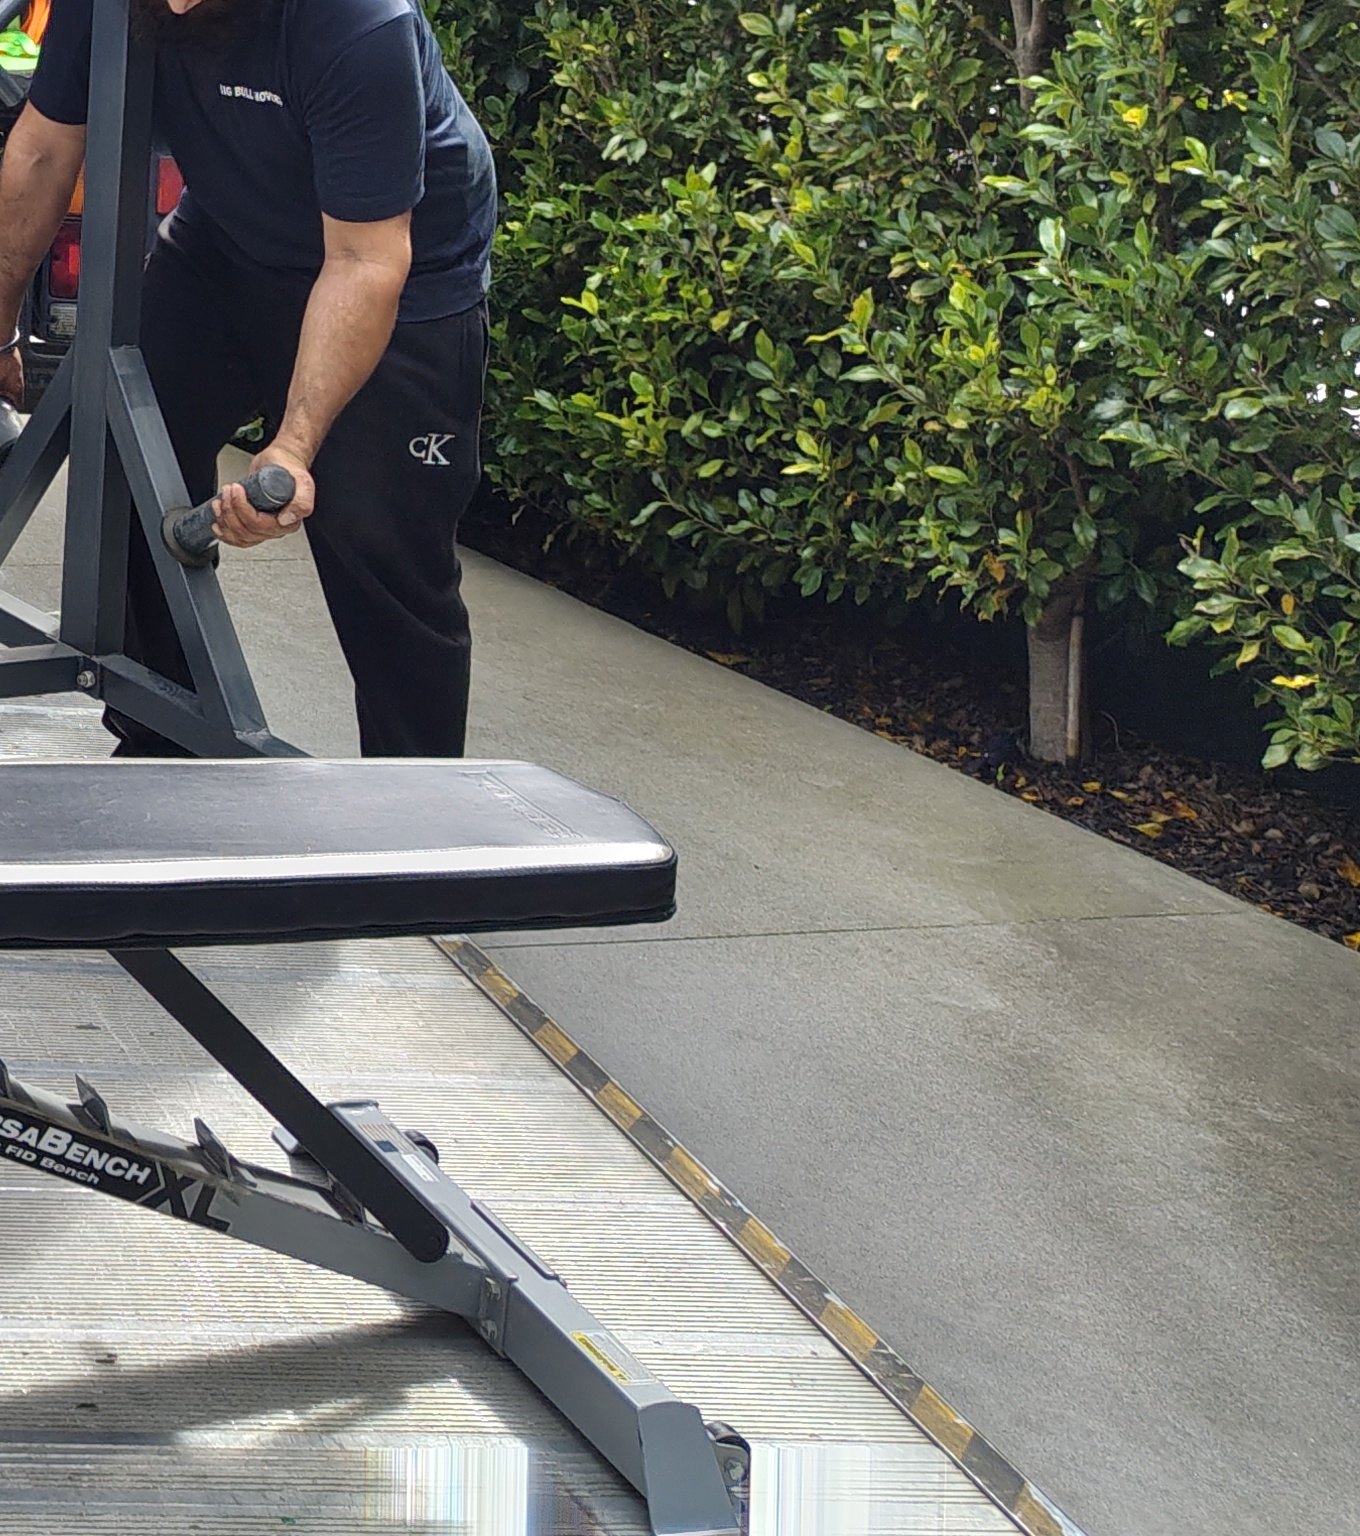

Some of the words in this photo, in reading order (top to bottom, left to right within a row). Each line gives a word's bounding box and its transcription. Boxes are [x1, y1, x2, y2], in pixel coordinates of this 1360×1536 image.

[5, 1144, 37, 1162] FID
[39, 1156, 100, 1186] Bench
[137, 1161, 230, 1232] XL
